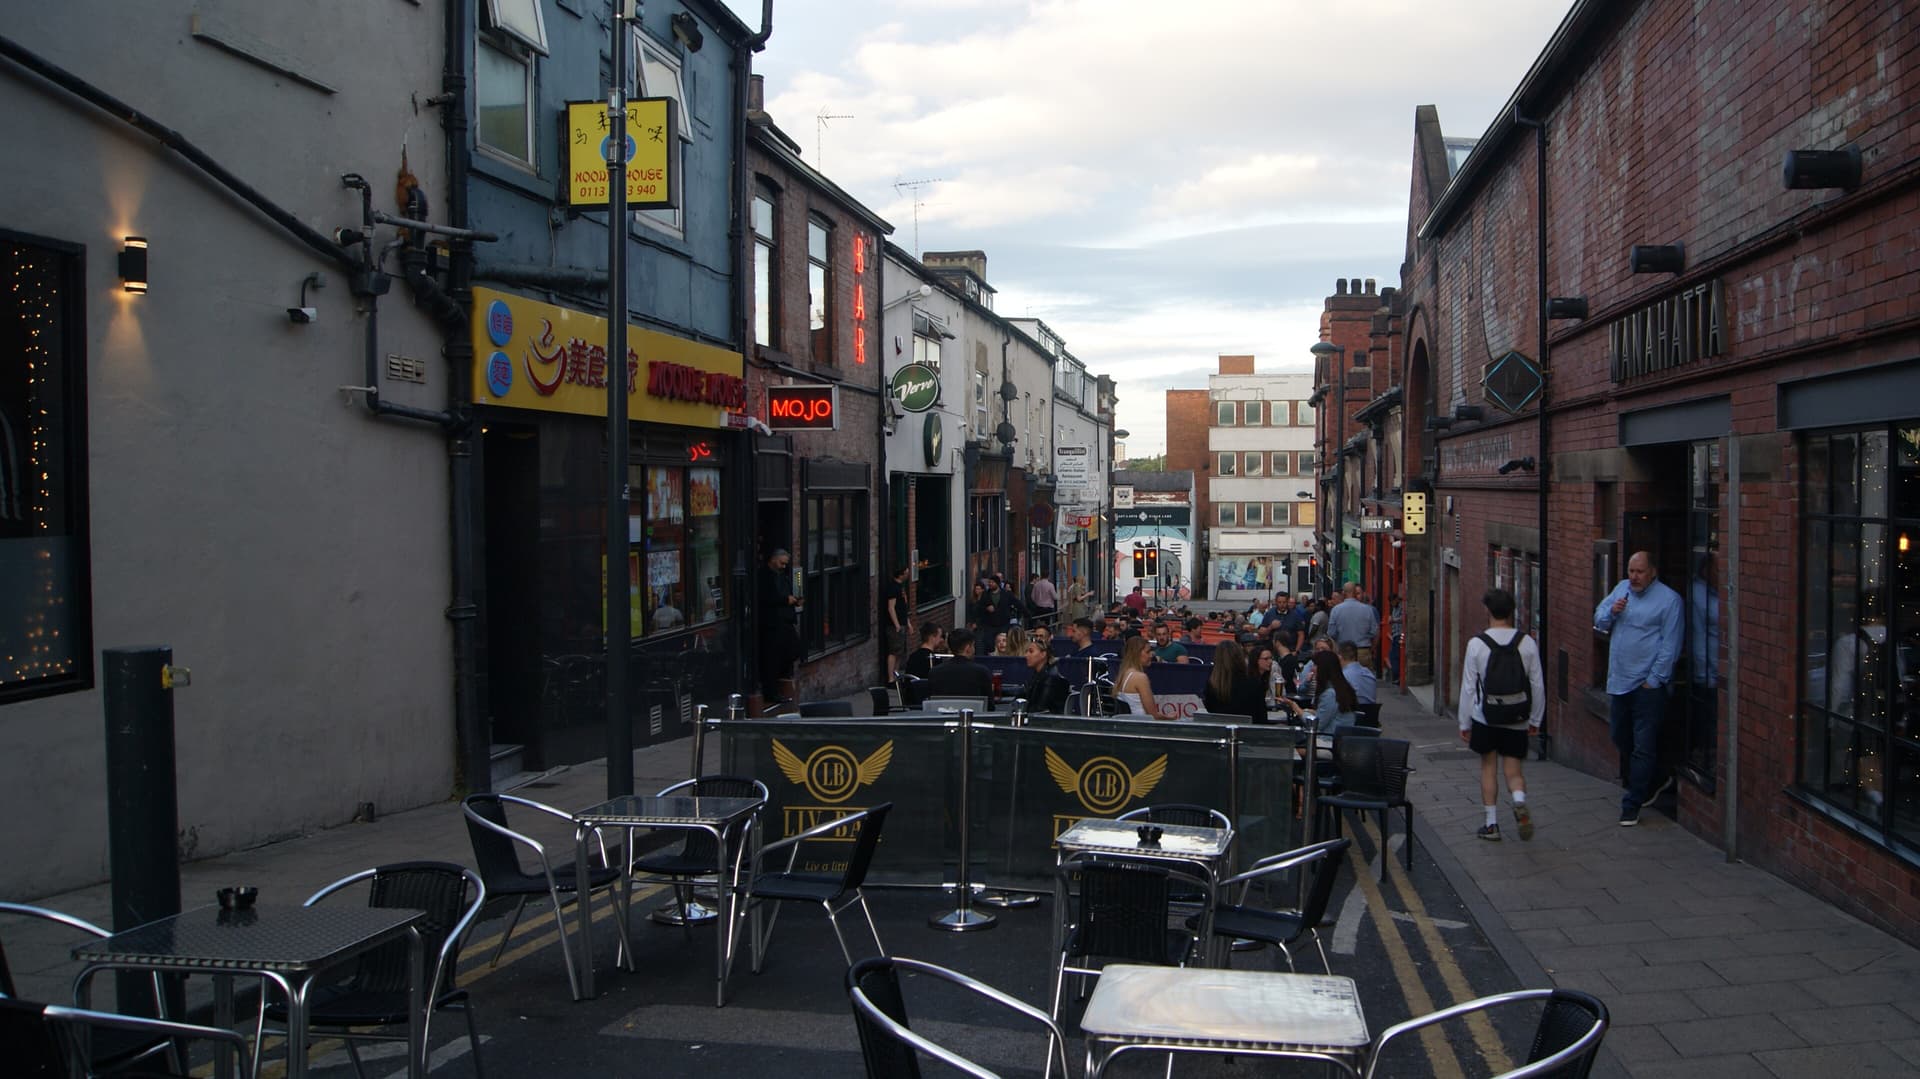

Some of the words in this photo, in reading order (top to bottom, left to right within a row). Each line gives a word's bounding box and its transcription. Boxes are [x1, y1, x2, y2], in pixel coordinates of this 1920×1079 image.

[580, 184, 605, 197] 0113
[636, 184, 656, 195] 940
[854, 236, 866, 364] BAR
[1609, 278, 1726, 383] MANAHATTA
[895, 378, 935, 402] Verve
[772, 400, 832, 421] MOJO
[1155, 702, 1199, 719] OJO
[822, 762, 845, 786] LB
[1094, 772, 1117, 797] LB
[783, 809, 822, 837] LIV
[833, 810, 865, 837] BA
